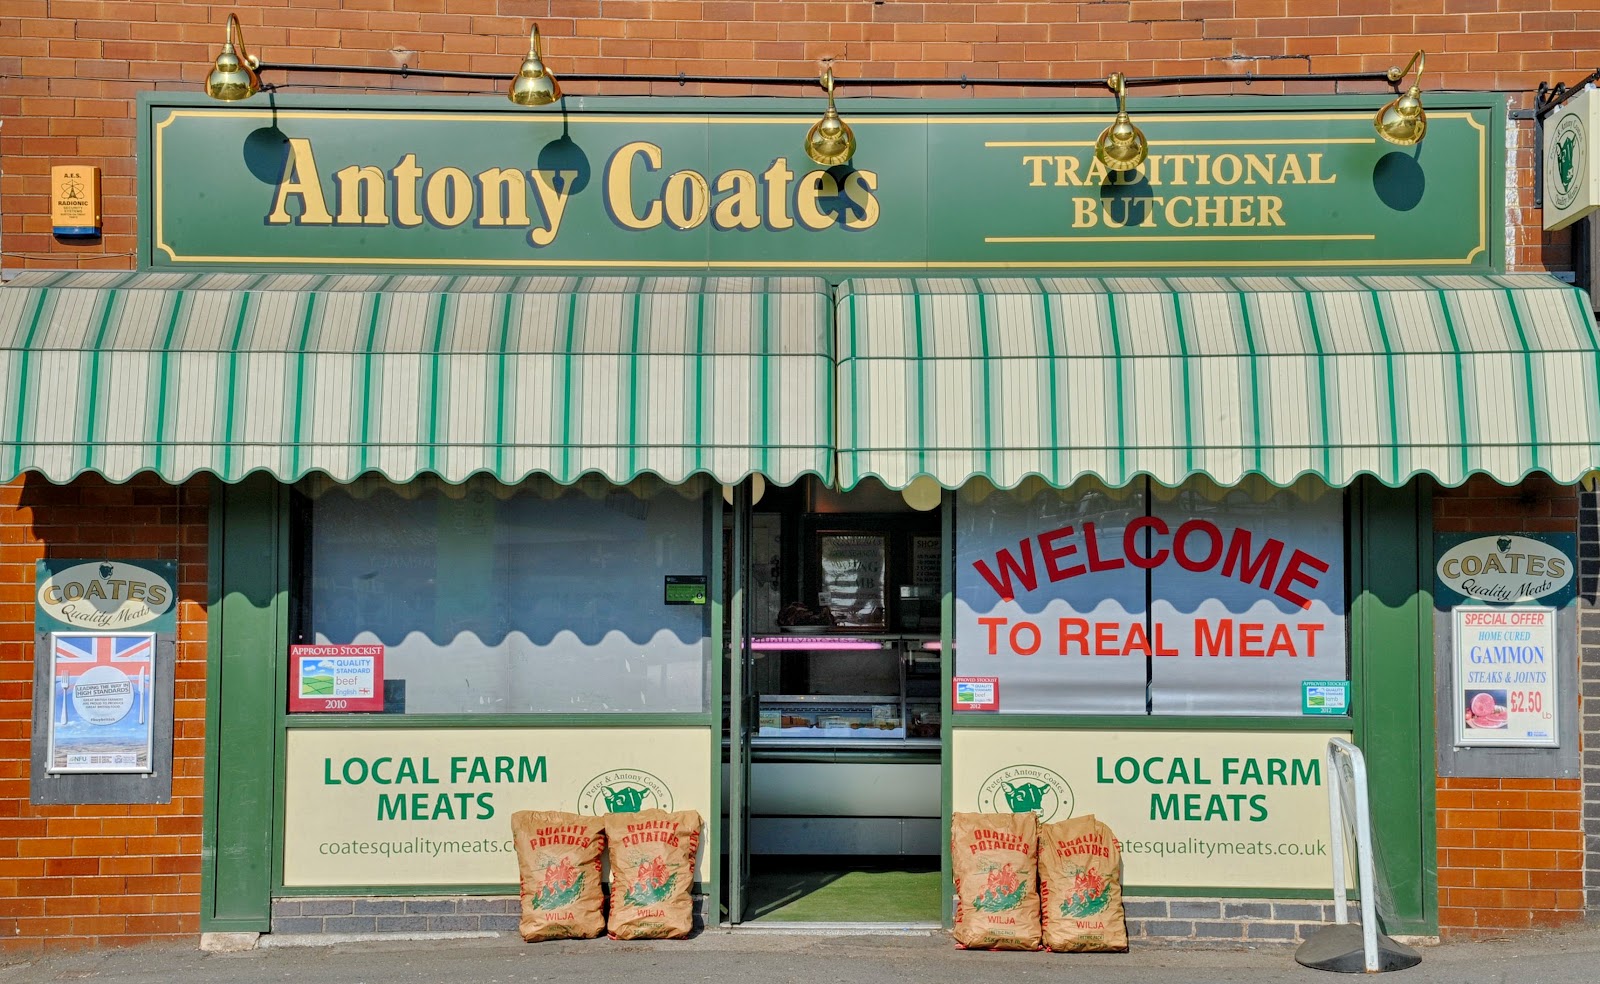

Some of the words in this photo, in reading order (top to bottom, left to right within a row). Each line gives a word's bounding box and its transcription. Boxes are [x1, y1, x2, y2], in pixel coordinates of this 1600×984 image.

[1022, 153, 1337, 187] TRADITIONAL
[267, 138, 580, 246] Antony
[607, 141, 880, 229] Coates
[1071, 195, 1286, 228] BUTCHER
[972, 516, 1329, 610] WELCOME
[1443, 553, 1565, 579] COATES
[43, 580, 167, 606] COATES
[1461, 579, 1511, 601] Quality
[1514, 580, 1552, 597] Meats
[61, 604, 111, 627] Quality
[114, 604, 150, 624] Meats
[1465, 613, 1507, 625] SPECIAL
[1510, 613, 1545, 625] OFFER
[1478, 631, 1502, 641] HOME
[1503, 631, 1531, 641] CURED
[292, 647, 338, 655] APPROVED
[340, 646, 382, 655] STOCKIST
[1470, 646, 1544, 664] GAMMON
[336, 676, 358, 685] beef
[1468, 671, 1502, 684] STEAKS
[1504, 672, 1512, 684] &
[1513, 671, 1546, 684] JOINTS
[325, 700, 347, 709] 2010
[1510, 691, 1542, 713] £2.50
[324, 757, 440, 785] LOCAL
[450, 756, 548, 784] FARM
[1096, 756, 1211, 784] LOCAL
[1222, 758, 1321, 786] FARM
[586, 780, 603, 798] Peter
[614, 773, 642, 782] Antony
[643, 776, 664, 798] Coates
[986, 776, 1003, 793] Peter
[1014, 769, 1042, 778] Antony
[1043, 772, 1065, 794] Coates
[377, 792, 496, 821] MEATS
[1149, 794, 1269, 822] MEATS
[536, 825, 588, 836] QUALITY
[627, 821, 679, 833] QUALITY
[974, 829, 1024, 842] QUALITY
[530, 834, 591, 850] POTATOES
[622, 830, 679, 848] POTATOES
[970, 840, 1030, 855] POTATOES
[1058, 833, 1103, 849] QUALITY
[1057, 844, 1110, 859] POTATOES
[545, 912, 575, 921] WILJA
[637, 909, 665, 918] WILJA
[987, 915, 1016, 925] WILJA
[1076, 921, 1105, 930] WILJA
